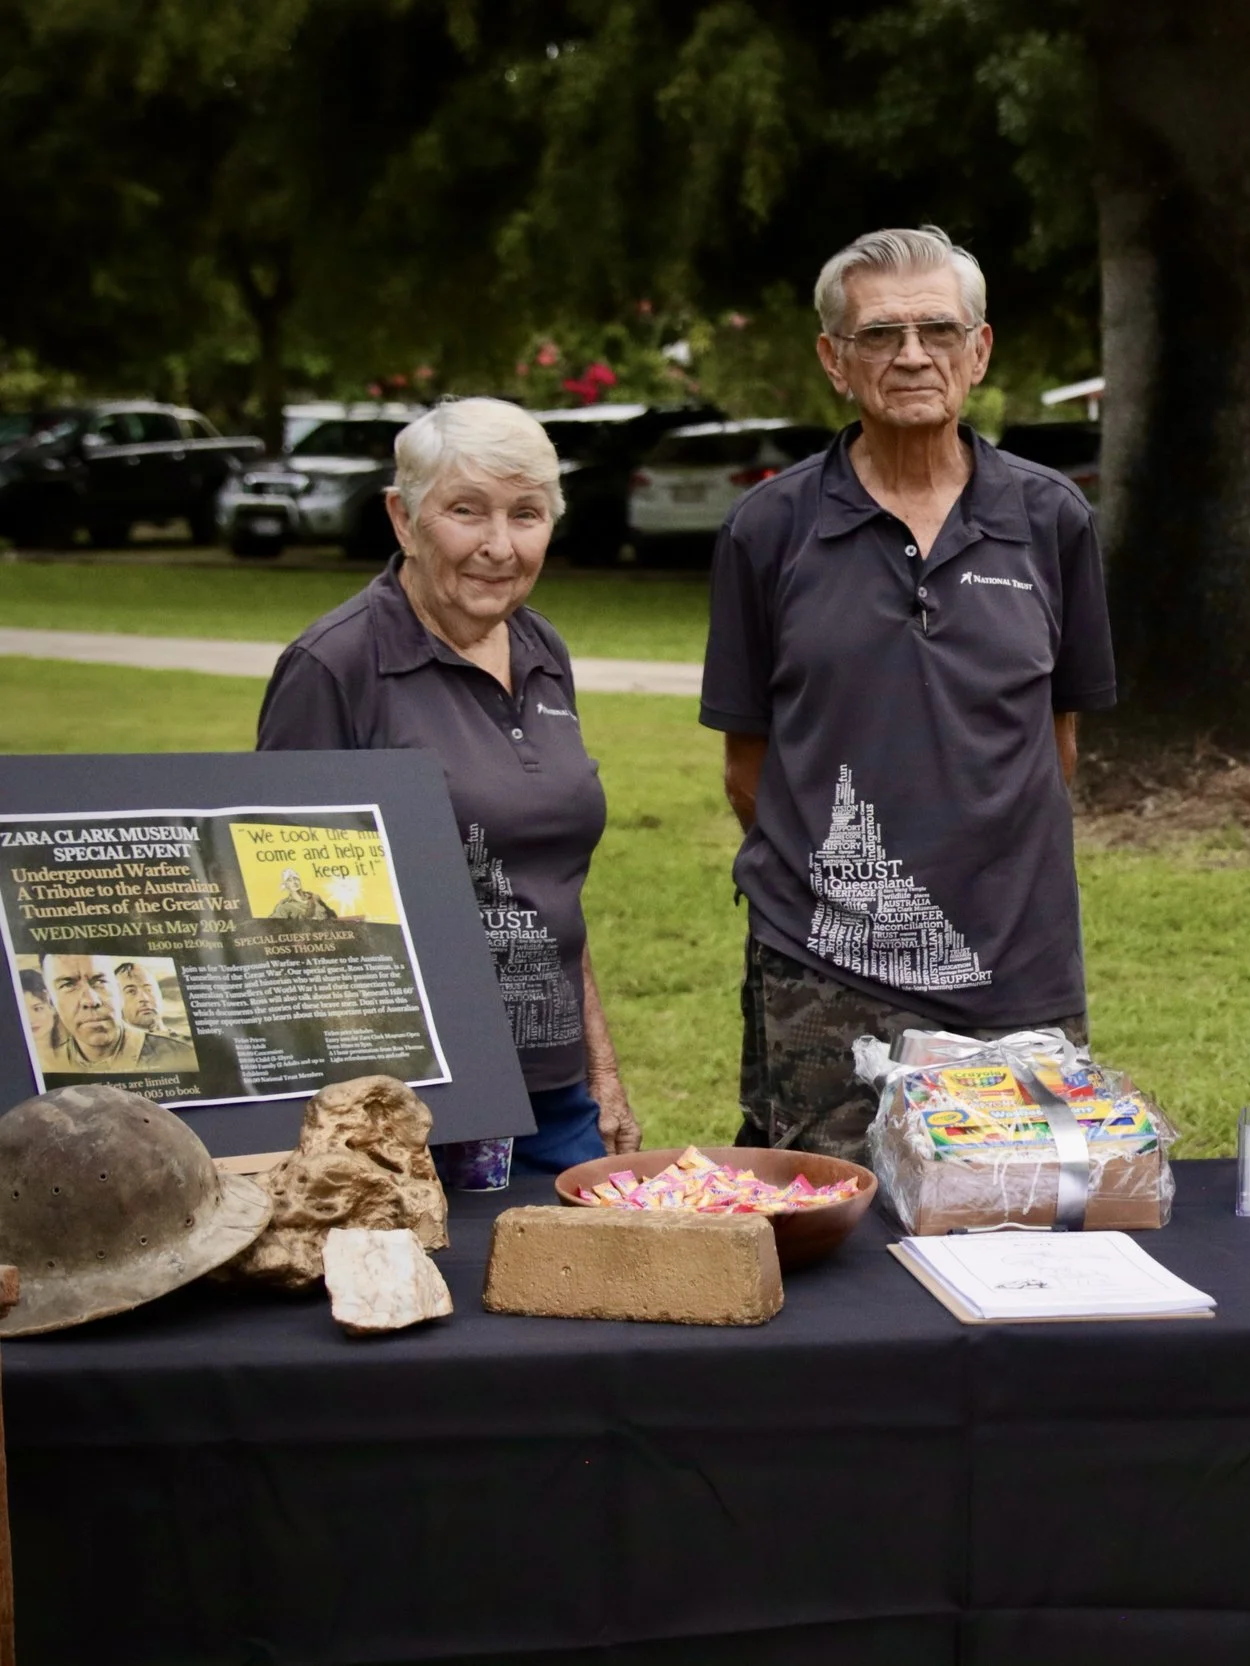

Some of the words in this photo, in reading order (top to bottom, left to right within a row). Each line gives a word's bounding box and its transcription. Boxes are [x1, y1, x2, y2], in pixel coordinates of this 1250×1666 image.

[1011, 579, 1033, 591] TRUST
[838, 764, 848, 782] fun
[1, 831, 54, 847] ZARA
[54, 828, 118, 844] CLARK
[120, 826, 200, 843] MUSEUM
[280, 827, 320, 843] took
[866, 804, 878, 861] Indigenous
[53, 846, 131, 862] SPECIAL
[134, 844, 192, 859] EVENT
[256, 850, 296, 862] come
[304, 845, 329, 860] and
[335, 844, 365, 860] help
[370, 845, 385, 857] us
[823, 842, 861, 850] HISTORY
[12, 865, 124, 883] Underground
[125, 862, 190, 878] Warfare
[312, 863, 350, 879] keep
[823, 860, 903, 880] TRUST
[17, 888, 32, 901] A
[32, 885, 95, 900] Tribute
[97, 885, 113, 897] to
[117, 883, 141, 895] the
[144, 879, 220, 894] Australian
[829, 876, 915, 890] Queensland
[828, 889, 876, 898] HERITAGE
[20, 902, 110, 919] Tunnellers
[112, 900, 130, 914] of
[135, 899, 160, 913] the
[162, 897, 204, 912] Great
[208, 897, 240, 910] War
[883, 898, 931, 908] AUSTRALIA
[480, 911, 537, 928] UST
[870, 910, 944, 923] VOLUNTEER
[29, 922, 146, 941] WEDNESDAY
[167, 921, 198, 936] May
[201, 919, 237, 933] 2024
[485, 927, 548, 939] eensland
[873, 921, 943, 931] Reconciliation
[173, 941, 183, 949] to
[234, 935, 278, 947] SPECIAL
[278, 933, 311, 944] GUEST
[312, 931, 355, 942] SPEAKER
[833, 925, 847, 966] discover
[872, 940, 920, 949] NATIONAL
[264, 946, 291, 956] ROSS
[293, 943, 336, 953] THOMAS
[928, 928, 940, 985] AUSTRALIAN
[903, 950, 911, 984] HISTORY
[940, 970, 992, 985] SUPPORT
[128, 1081, 144, 1089] are
[144, 1074, 180, 1087] limited
[165, 1089, 175, 1097] to
[176, 1085, 201, 1096] book
